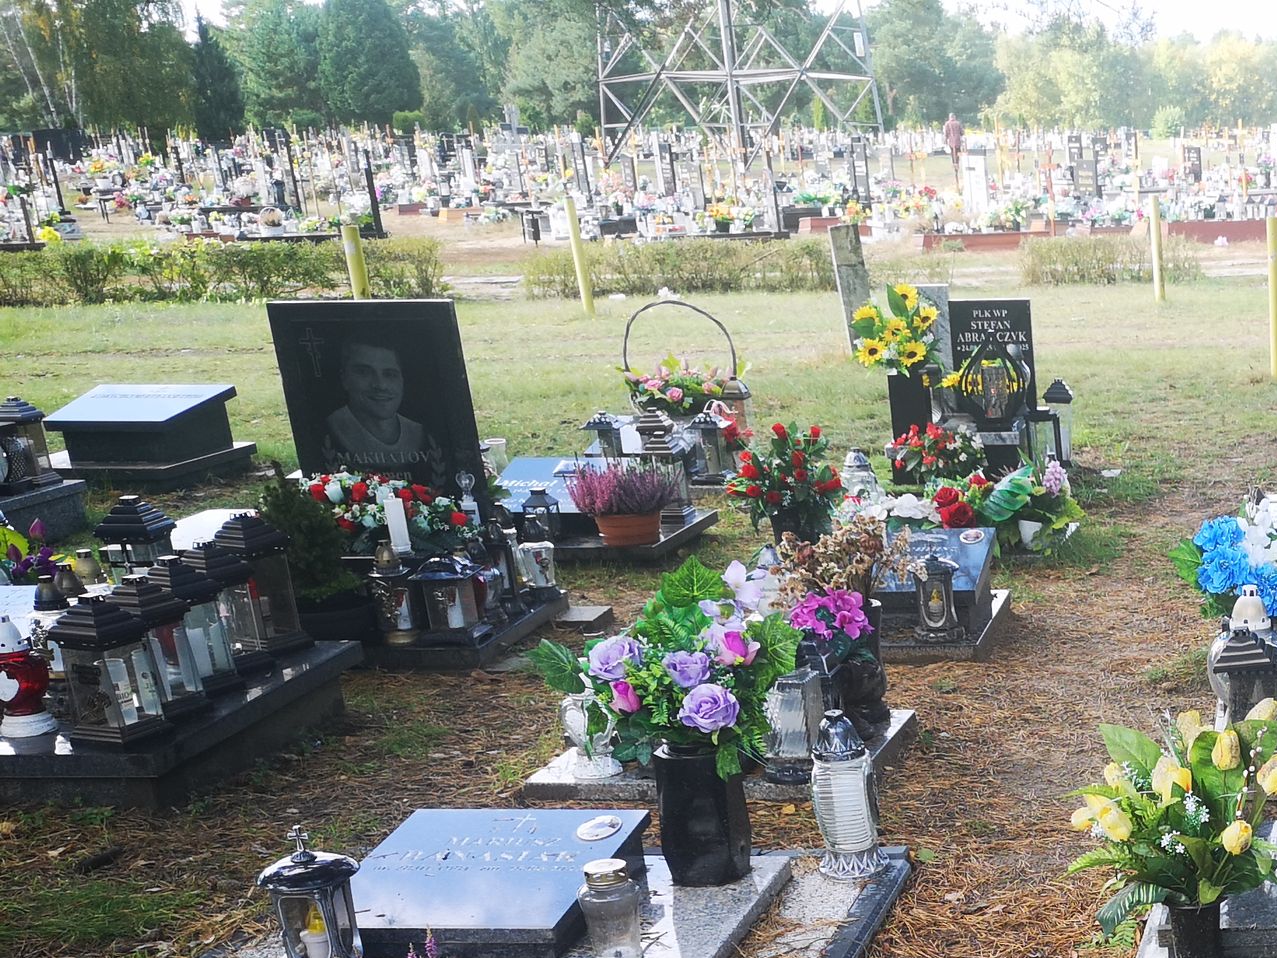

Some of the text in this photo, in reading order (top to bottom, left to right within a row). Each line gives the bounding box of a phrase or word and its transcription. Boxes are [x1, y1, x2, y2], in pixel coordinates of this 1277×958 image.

[973, 309, 1008, 318] PLK WP
[970, 320, 1011, 330] STEFAN
[957, 332, 1027, 343] ABRACZYK
